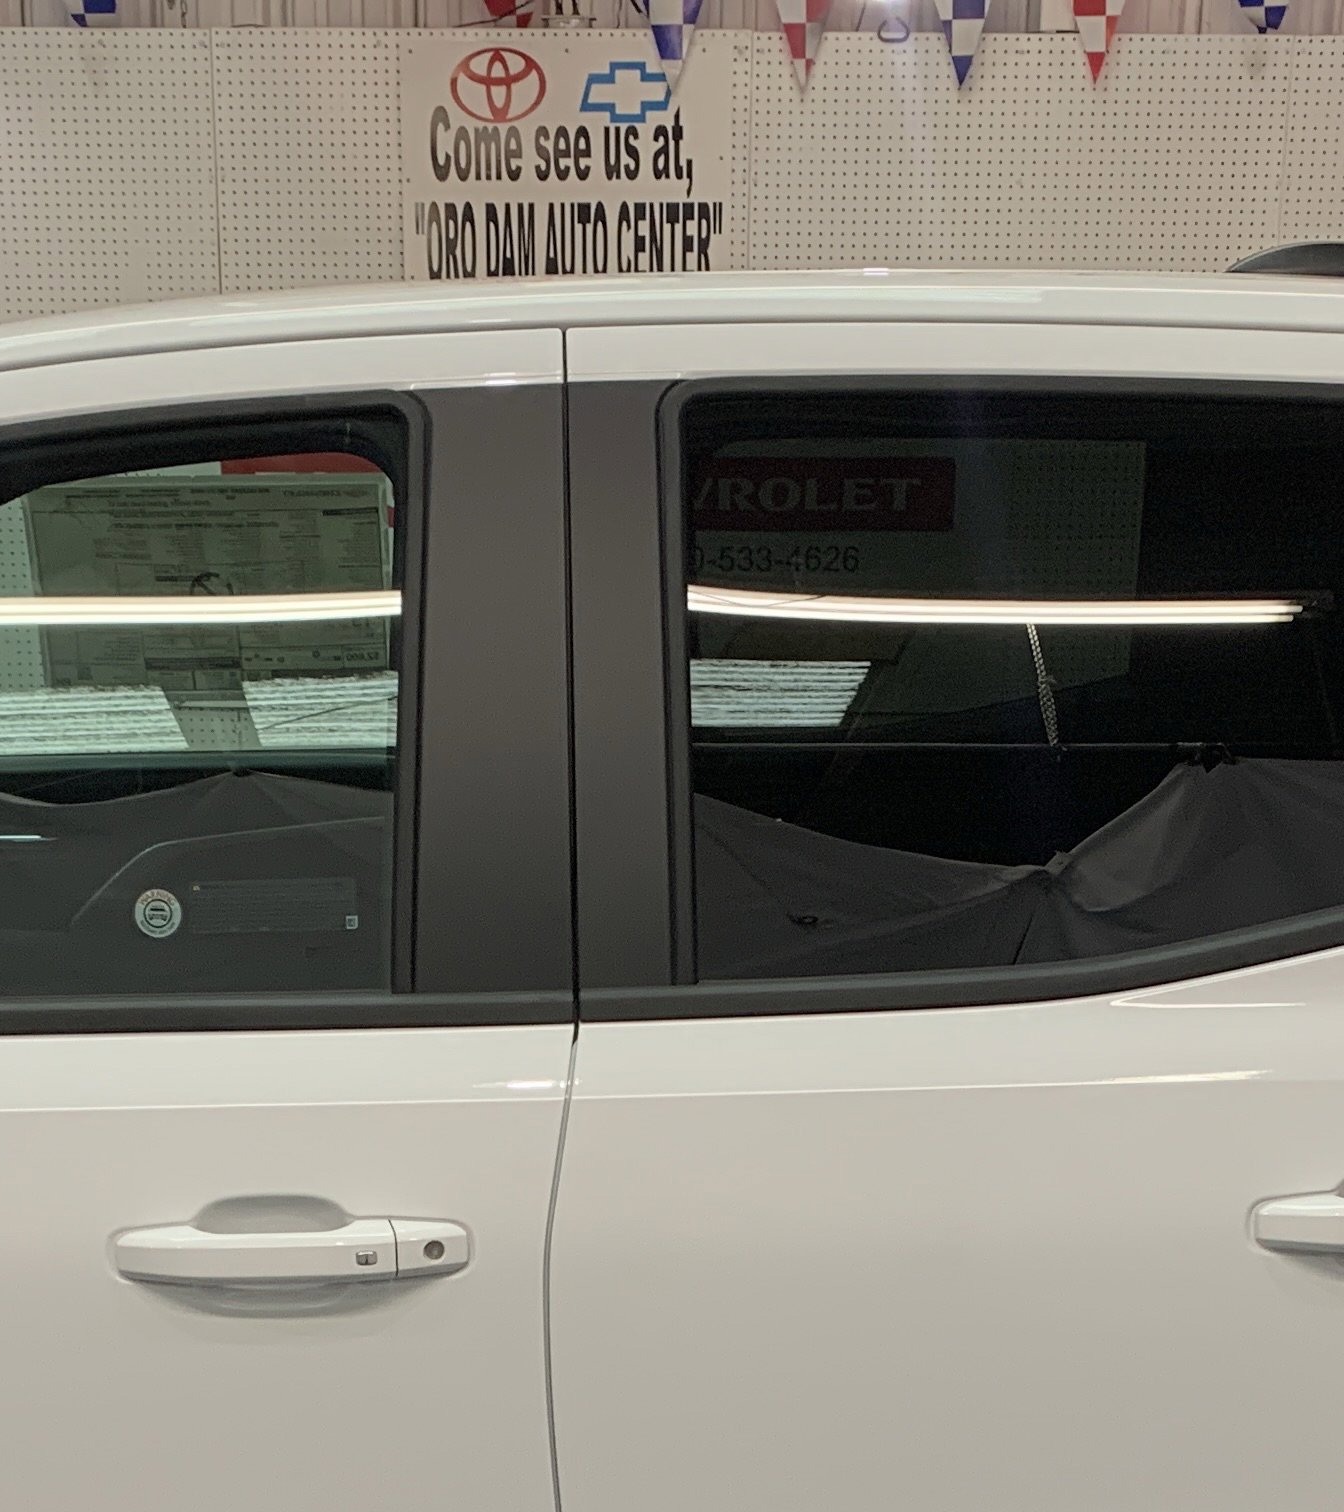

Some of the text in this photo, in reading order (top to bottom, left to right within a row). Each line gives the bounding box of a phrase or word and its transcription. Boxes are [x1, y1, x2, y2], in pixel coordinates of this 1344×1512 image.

[430, 105, 693, 198] Come see us at,
[485, 202, 535, 276] DAM
[545, 201, 608, 275] AUTO
[617, 201, 723, 273] CENTER"
